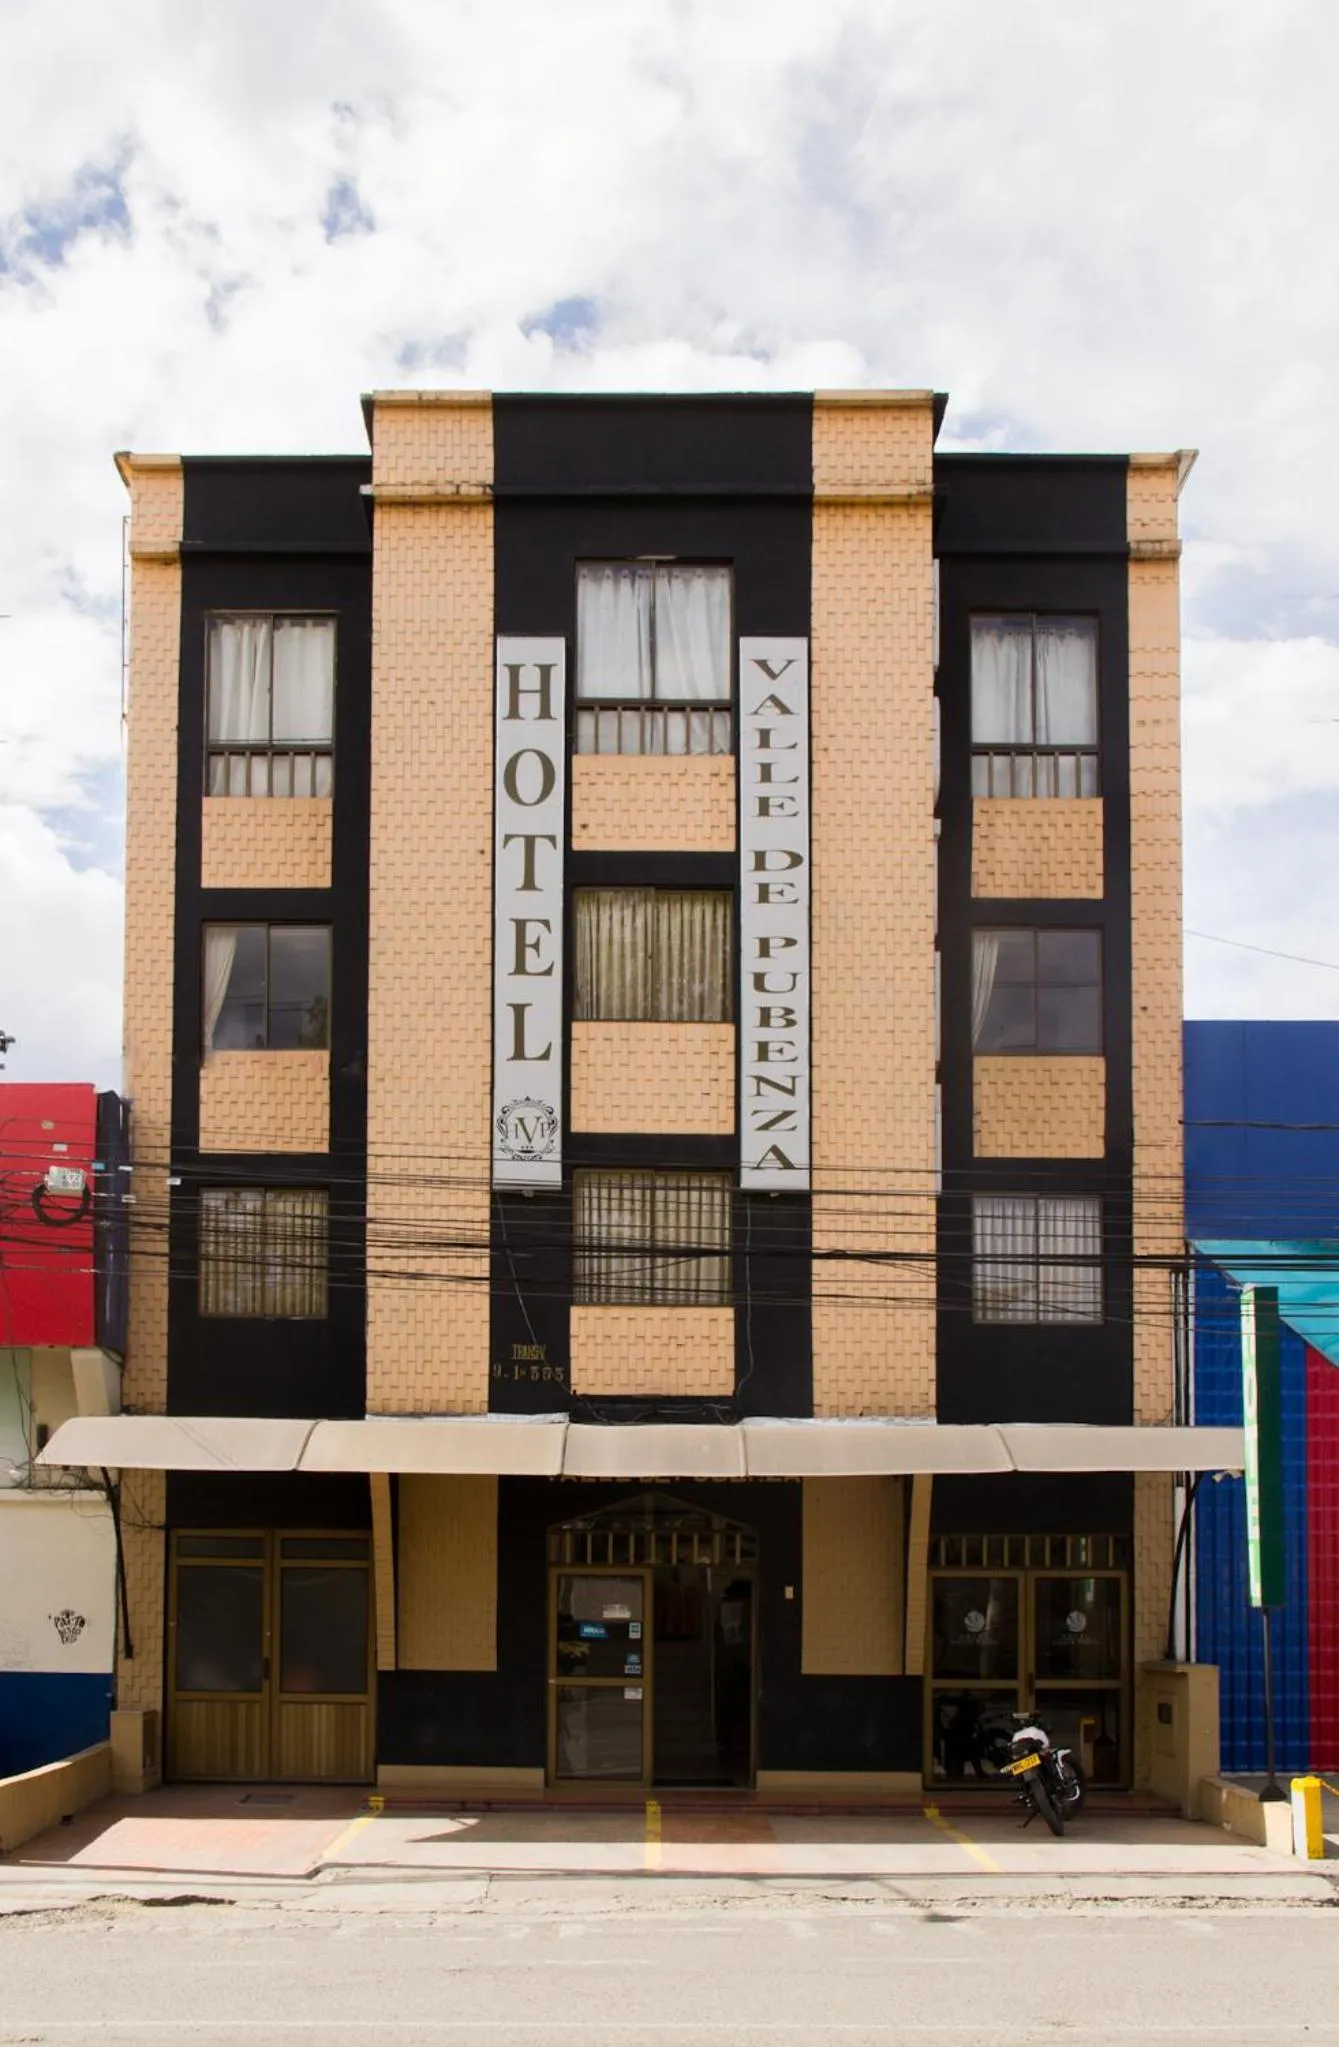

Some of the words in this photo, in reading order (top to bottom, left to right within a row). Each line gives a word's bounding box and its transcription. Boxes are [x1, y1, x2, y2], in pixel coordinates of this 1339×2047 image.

[748, 658, 801, 818] VALLE
[502, 663, 558, 1062] HOTEL
[748, 849, 805, 904] DE
[748, 936, 803, 1171] PUBENZA
